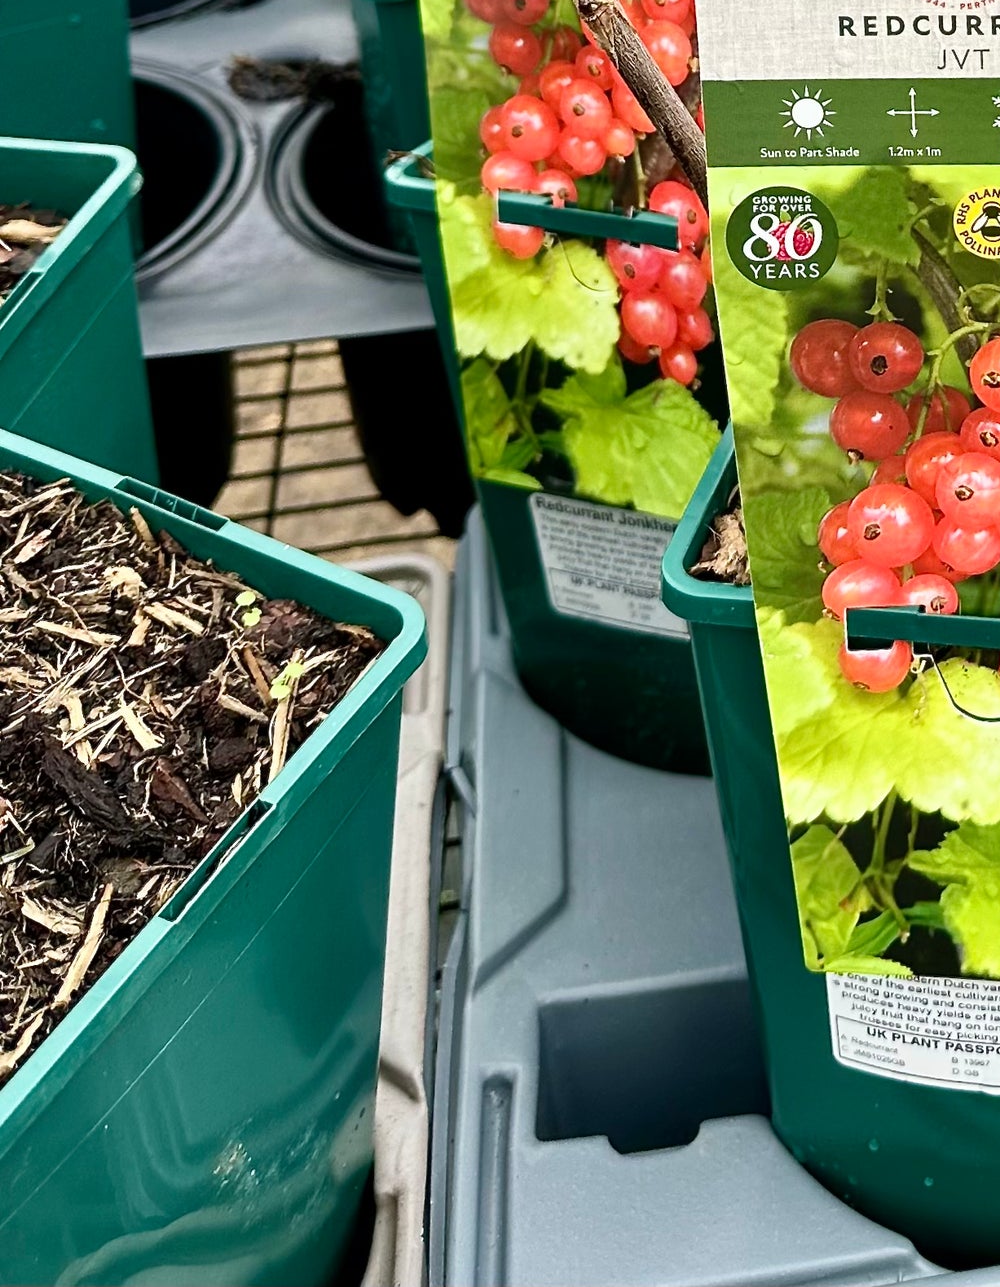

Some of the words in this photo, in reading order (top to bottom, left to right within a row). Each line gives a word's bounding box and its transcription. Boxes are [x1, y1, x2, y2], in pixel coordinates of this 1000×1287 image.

[936, 49, 991, 71] JVT
[760, 148, 781, 158] Sun
[784, 149, 797, 158] to
[800, 147, 823, 157] Part
[825, 147, 860, 157] Shade
[888, 147, 914, 157] 1.2m
[926, 147, 941, 157] 1m
[752, 195, 812, 205] GROWING
[752, 204, 776, 213] FOR
[780, 204, 812, 212] OVER
[957, 203, 970, 225] RHS
[743, 213, 823, 262] 80
[749, 263, 820, 279] YEARS
[536, 496, 615, 523] Redcurrant
[844, 981, 879, 996] strong
[883, 991, 929, 1006] growing
[933, 999, 954, 1007] and
[847, 972, 868, 983] one
[872, 978, 882, 986] of
[886, 979, 904, 990] the
[908, 985, 951, 997] earliest
[944, 978, 979, 990] Dutch
[842, 991, 894, 1008] produces
[898, 1002, 932, 1017] heavy
[937, 1009, 971, 1019] yields
[975, 1013, 986, 1021] of
[851, 1003, 877, 1015] juicy
[881, 1009, 903, 1020] fruit
[907, 1014, 928, 1023] that
[933, 1018, 962, 1030] hang
[860, 1013, 901, 1028] trusses
[905, 1023, 920, 1032] for
[924, 1028, 952, 1039] easy
[957, 1031, 999, 1042] picking
[867, 1026, 887, 1039] UK
[892, 1032, 940, 1049] PLANT
